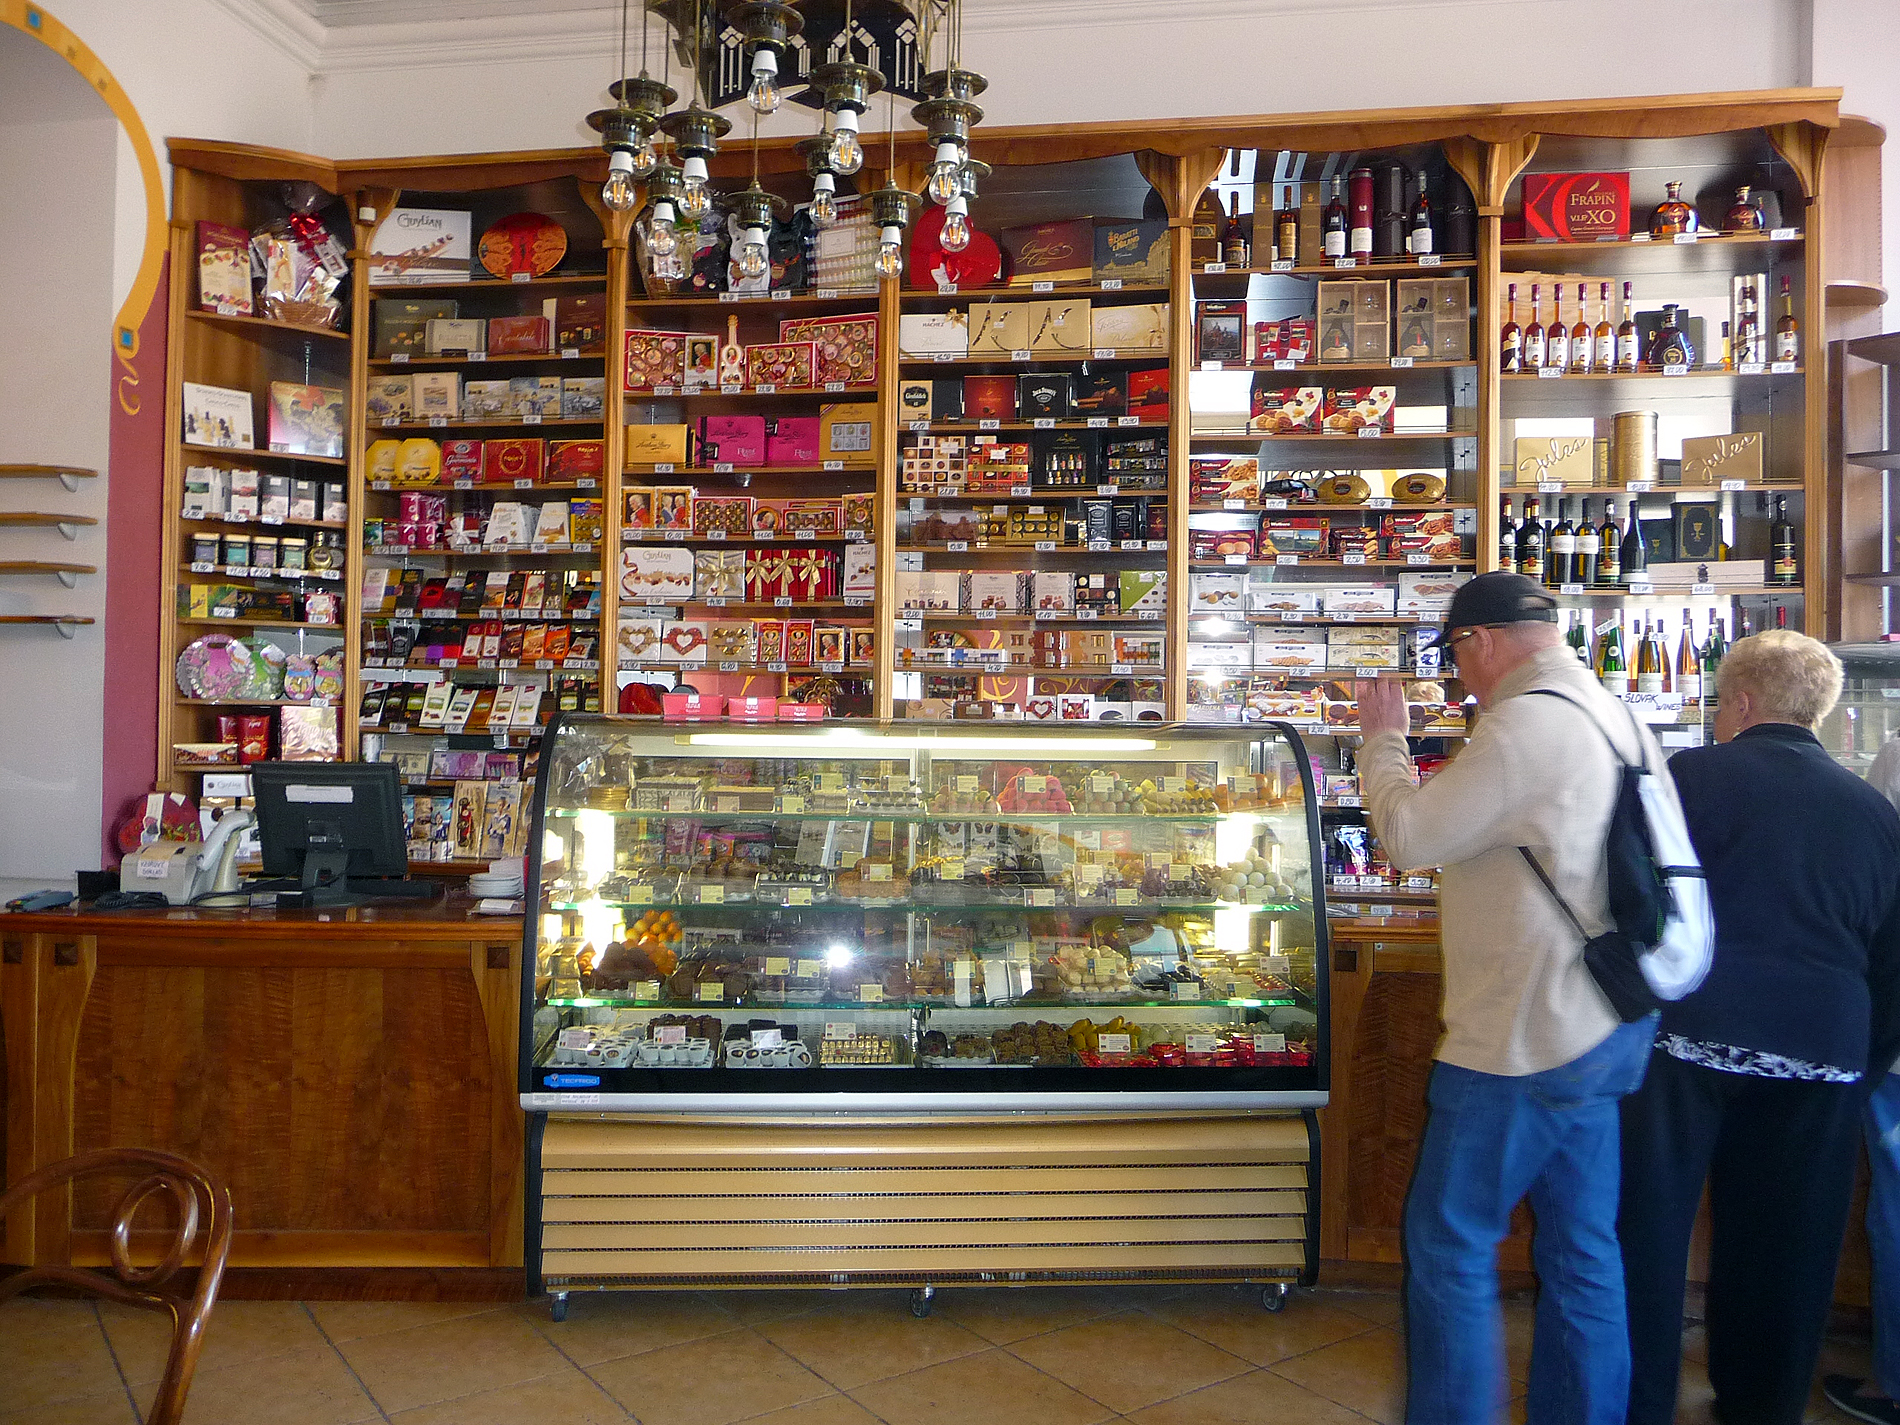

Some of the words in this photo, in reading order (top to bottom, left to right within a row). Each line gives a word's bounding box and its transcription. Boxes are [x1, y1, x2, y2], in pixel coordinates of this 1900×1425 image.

[1570, 194, 1616, 206] FRAPIN
[1586, 209, 1616, 224] XO
[1520, 436, 1588, 482] Jules
[1684, 434, 1756, 484] Jules
[1624, 692, 1658, 704] SLOVAK
[1655, 702, 1682, 710] WINES
